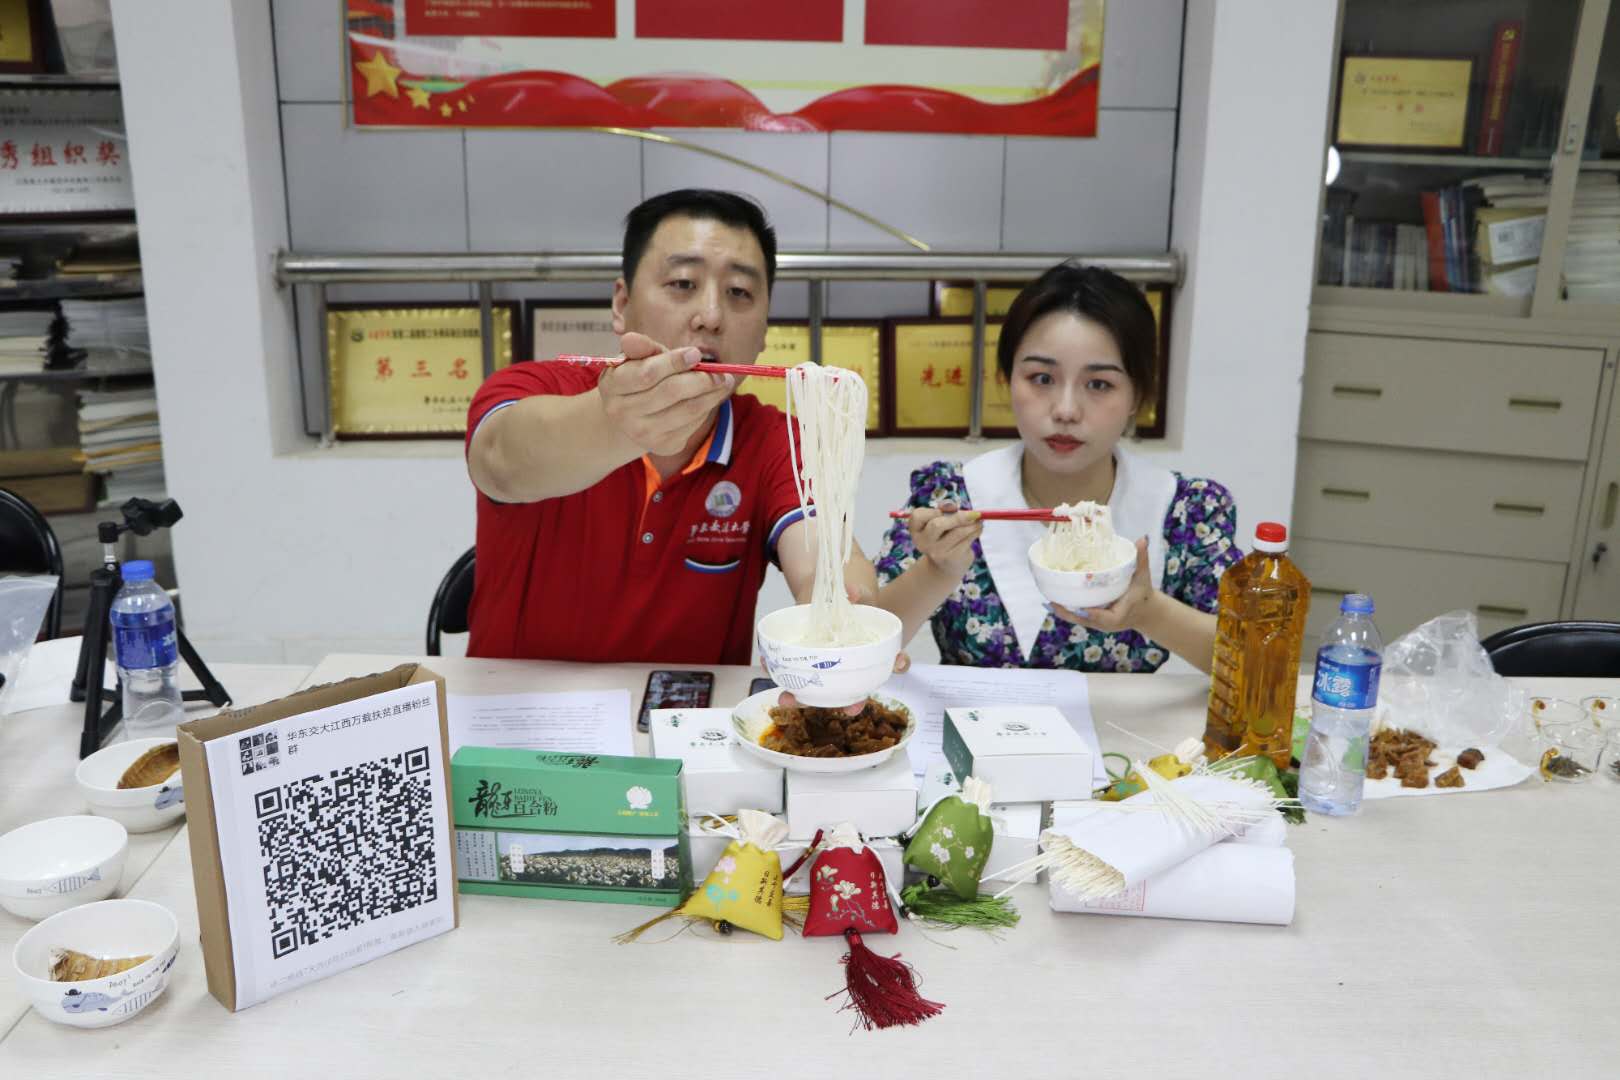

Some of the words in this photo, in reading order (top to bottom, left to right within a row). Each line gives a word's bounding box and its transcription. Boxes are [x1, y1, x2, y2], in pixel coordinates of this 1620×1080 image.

[376, 357, 468, 381] 第三名
[1316, 670, 1352, 697] 冰露
[287, 696, 431, 740] 华东交大江西万载扶贫直播粉丝
[288, 744, 299, 755] 群
